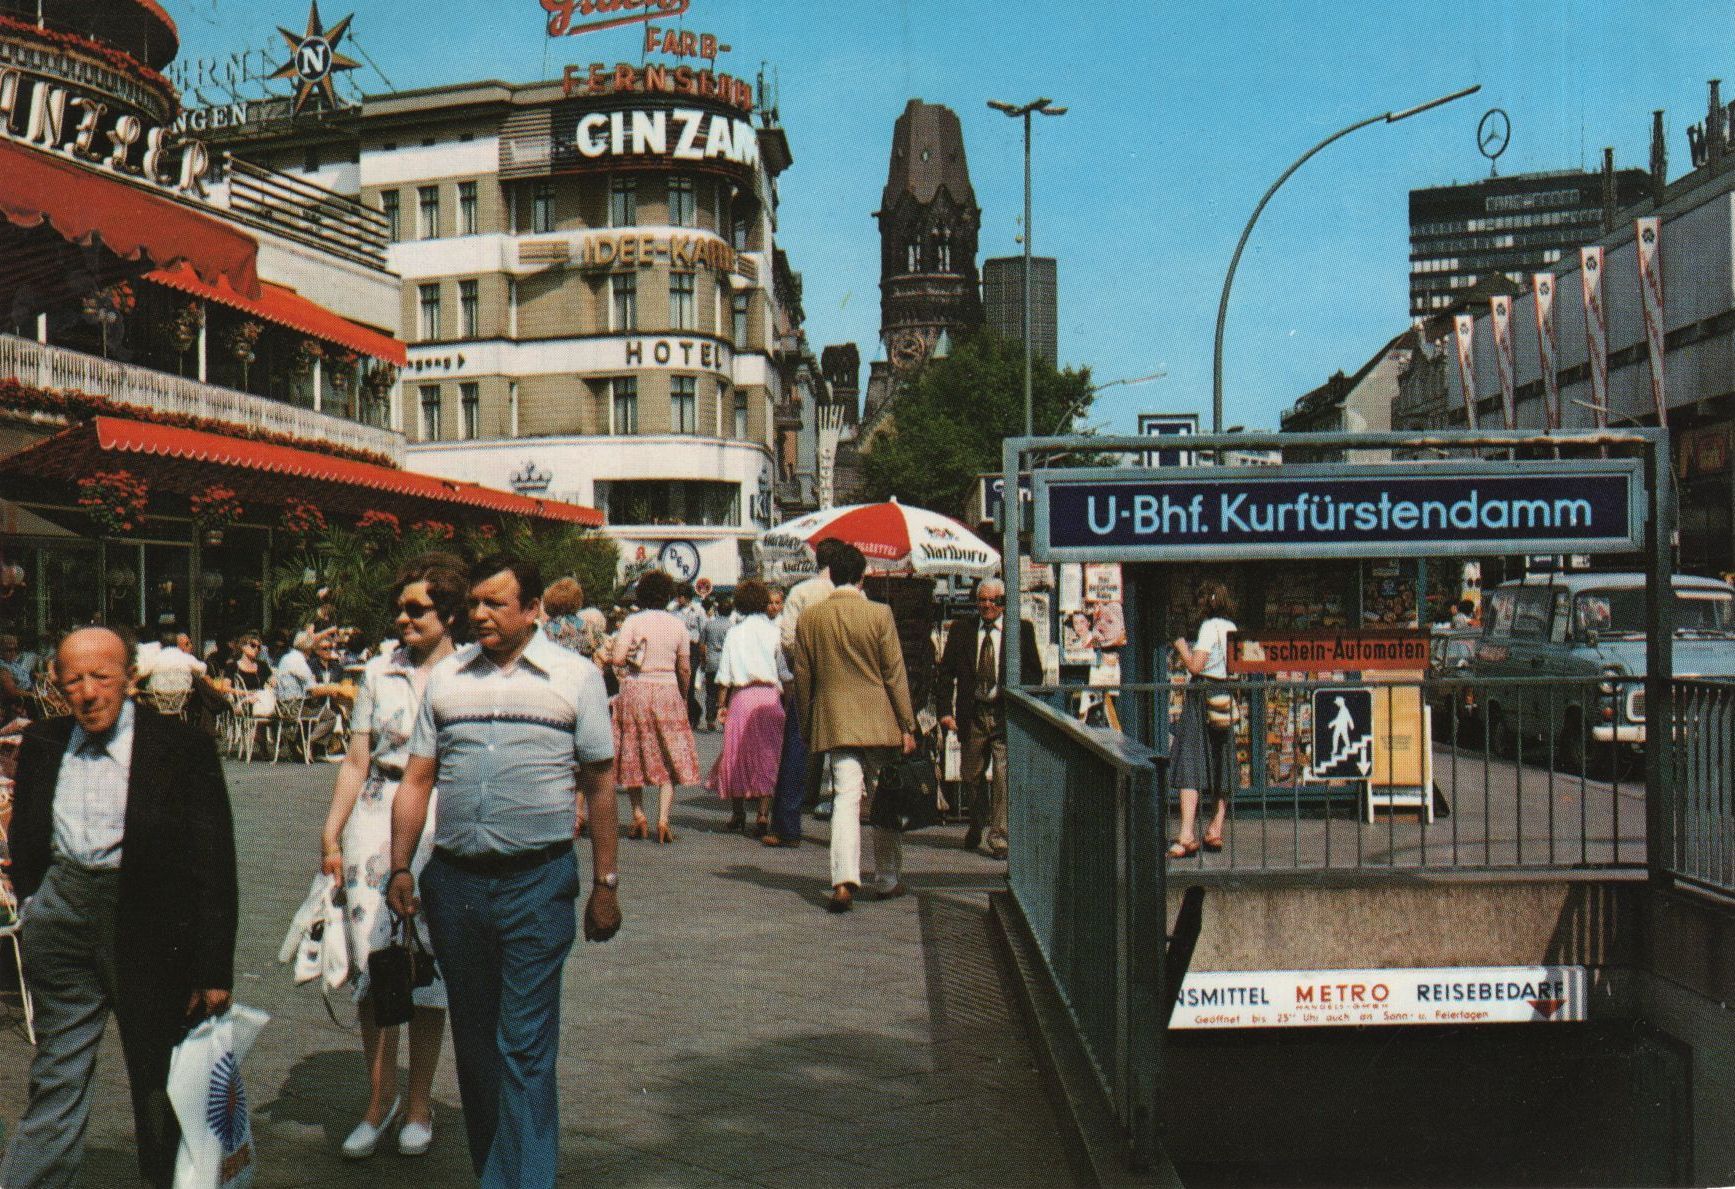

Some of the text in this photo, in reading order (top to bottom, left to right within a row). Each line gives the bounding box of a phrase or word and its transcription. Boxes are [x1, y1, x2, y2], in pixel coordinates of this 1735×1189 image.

[645, 26, 732, 59] FARB-
[301, 45, 326, 74] N
[626, 340, 722, 369] HOTEL
[1087, 489, 1592, 534] U-Bhf. Kurfürstendamm
[669, 547, 690, 577] DER
[920, 543, 988, 563] Marlboro
[1233, 636, 1425, 662] Frschein-Automaten
[1296, 984, 1389, 1003] METRO
[1417, 982, 1563, 1001] REISEBEDARF
[1252, 1013, 1267, 1024] bis
[1435, 1009, 1489, 1021] Feiertagen
